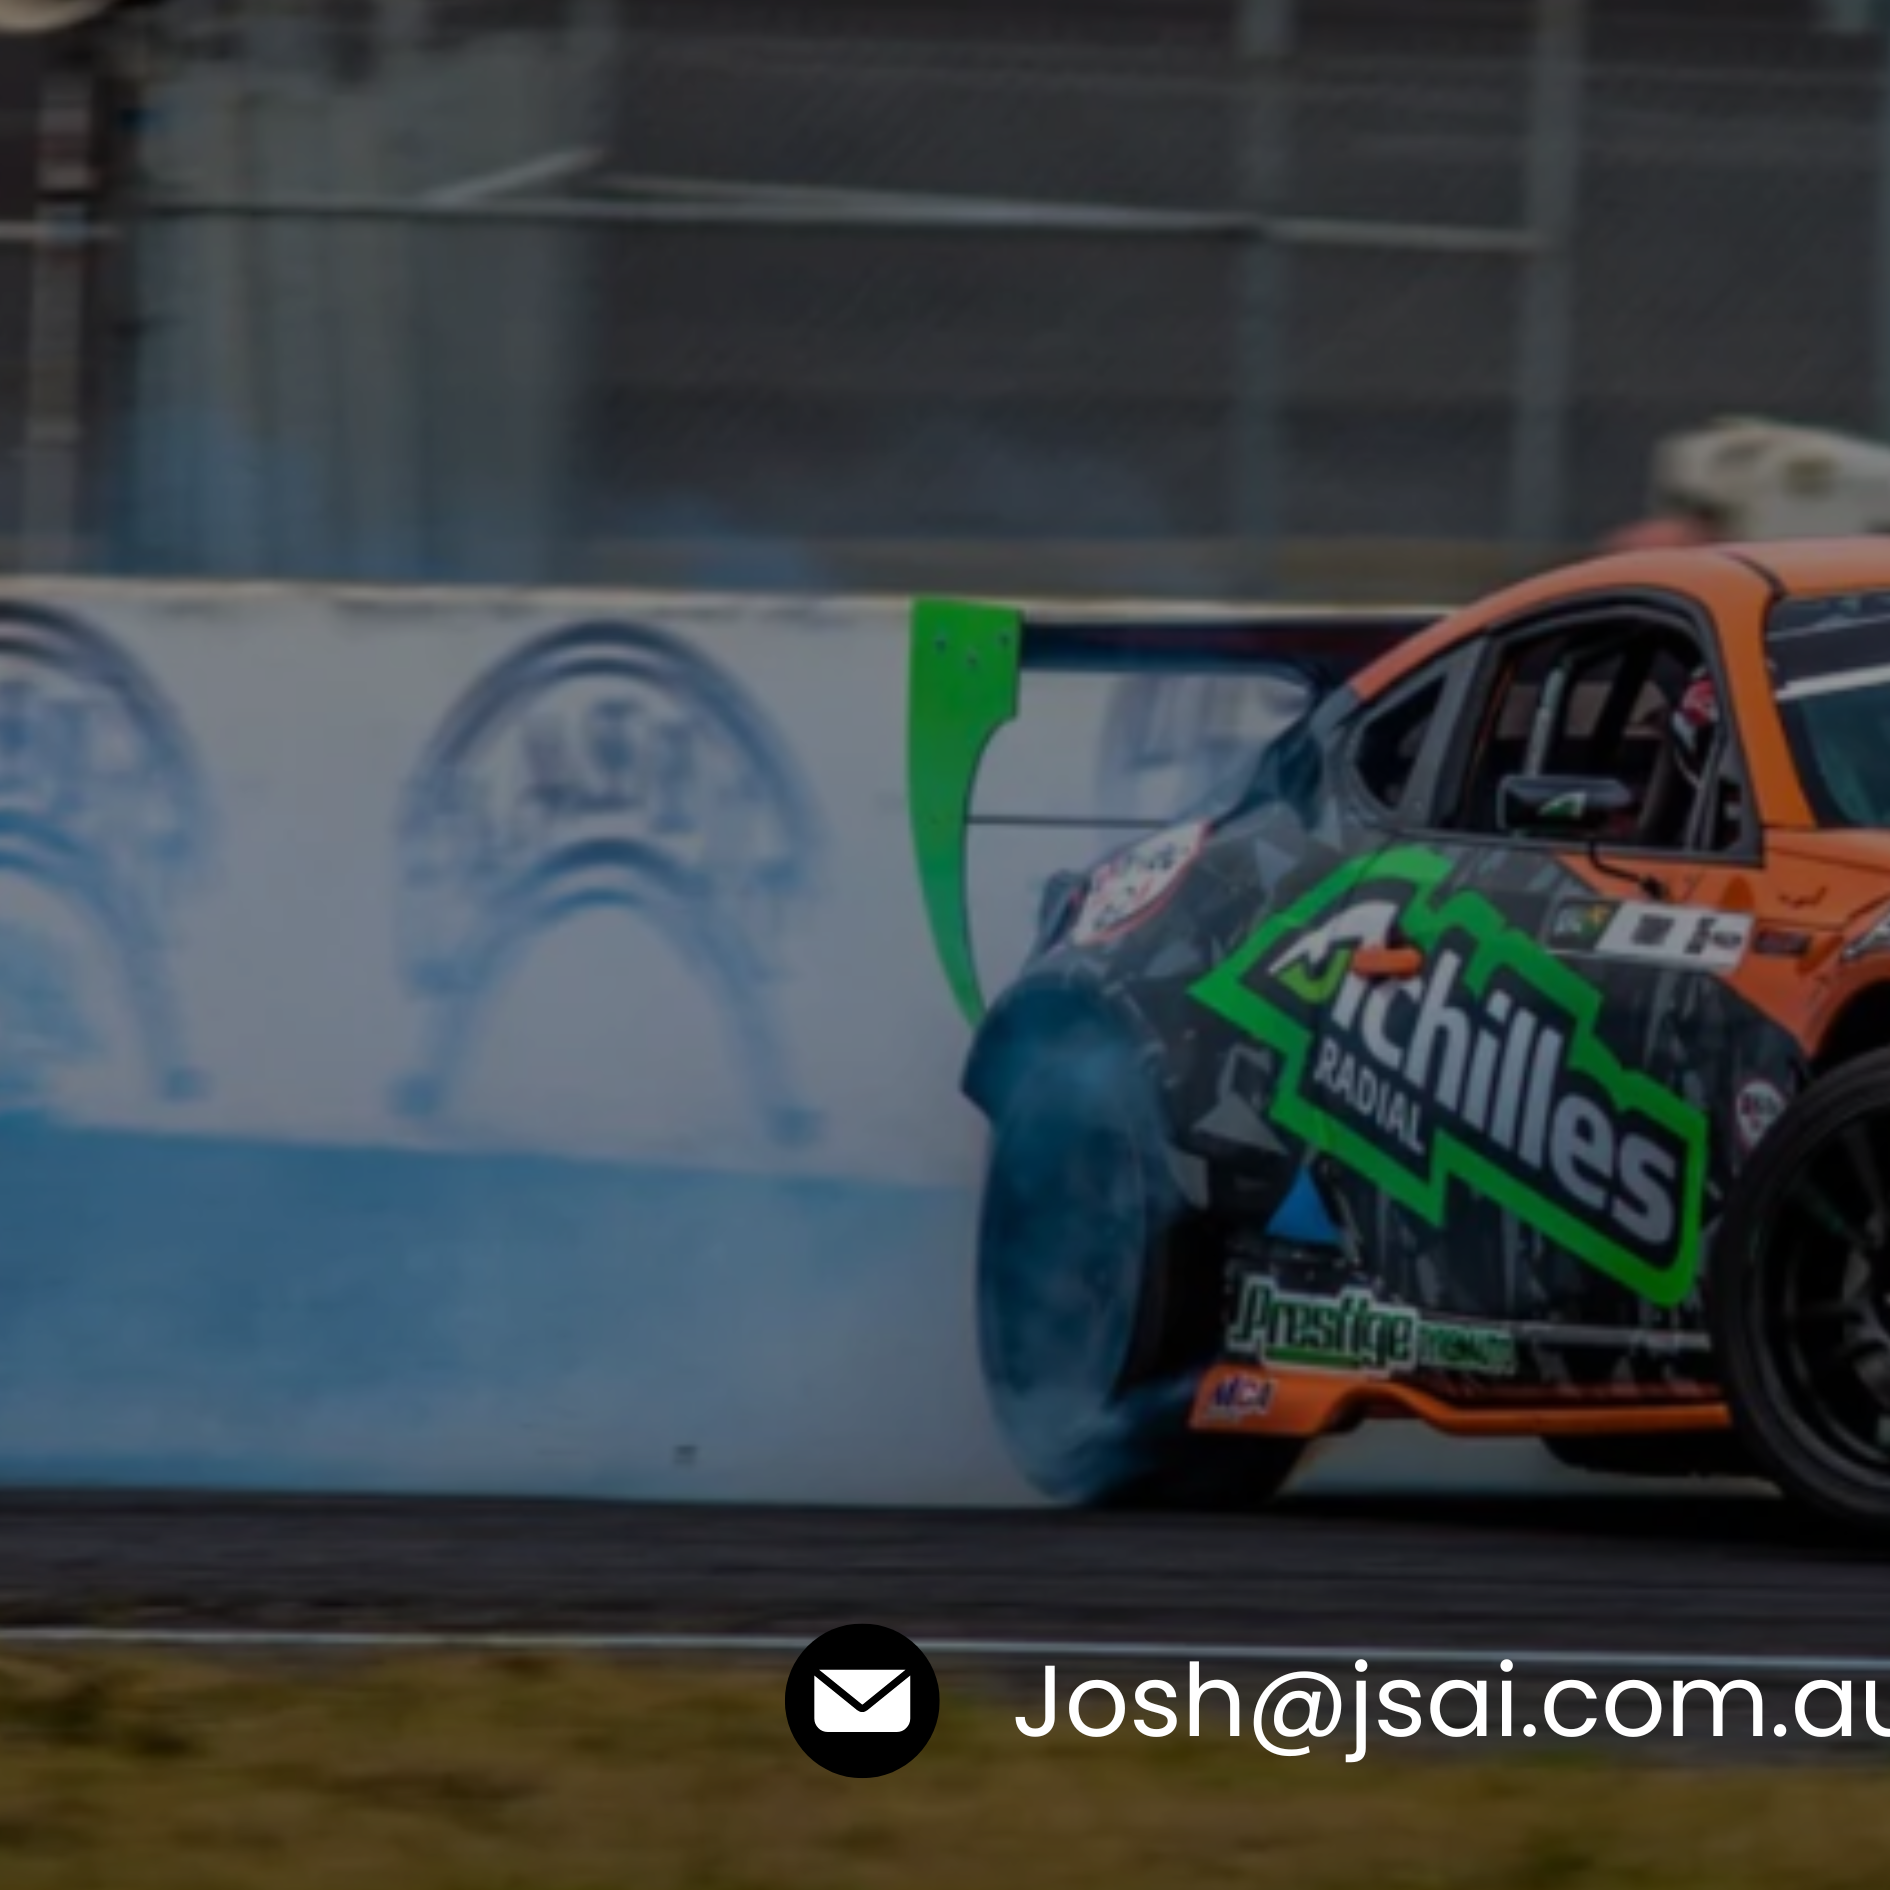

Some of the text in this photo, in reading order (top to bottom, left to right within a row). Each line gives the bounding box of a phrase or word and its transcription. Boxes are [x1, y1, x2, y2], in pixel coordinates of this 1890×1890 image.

[1269, 902, 1678, 1245] Achilles
[1313, 1038, 1426, 1155] RADIAL
[1228, 1275, 1418, 1376] Prestige
